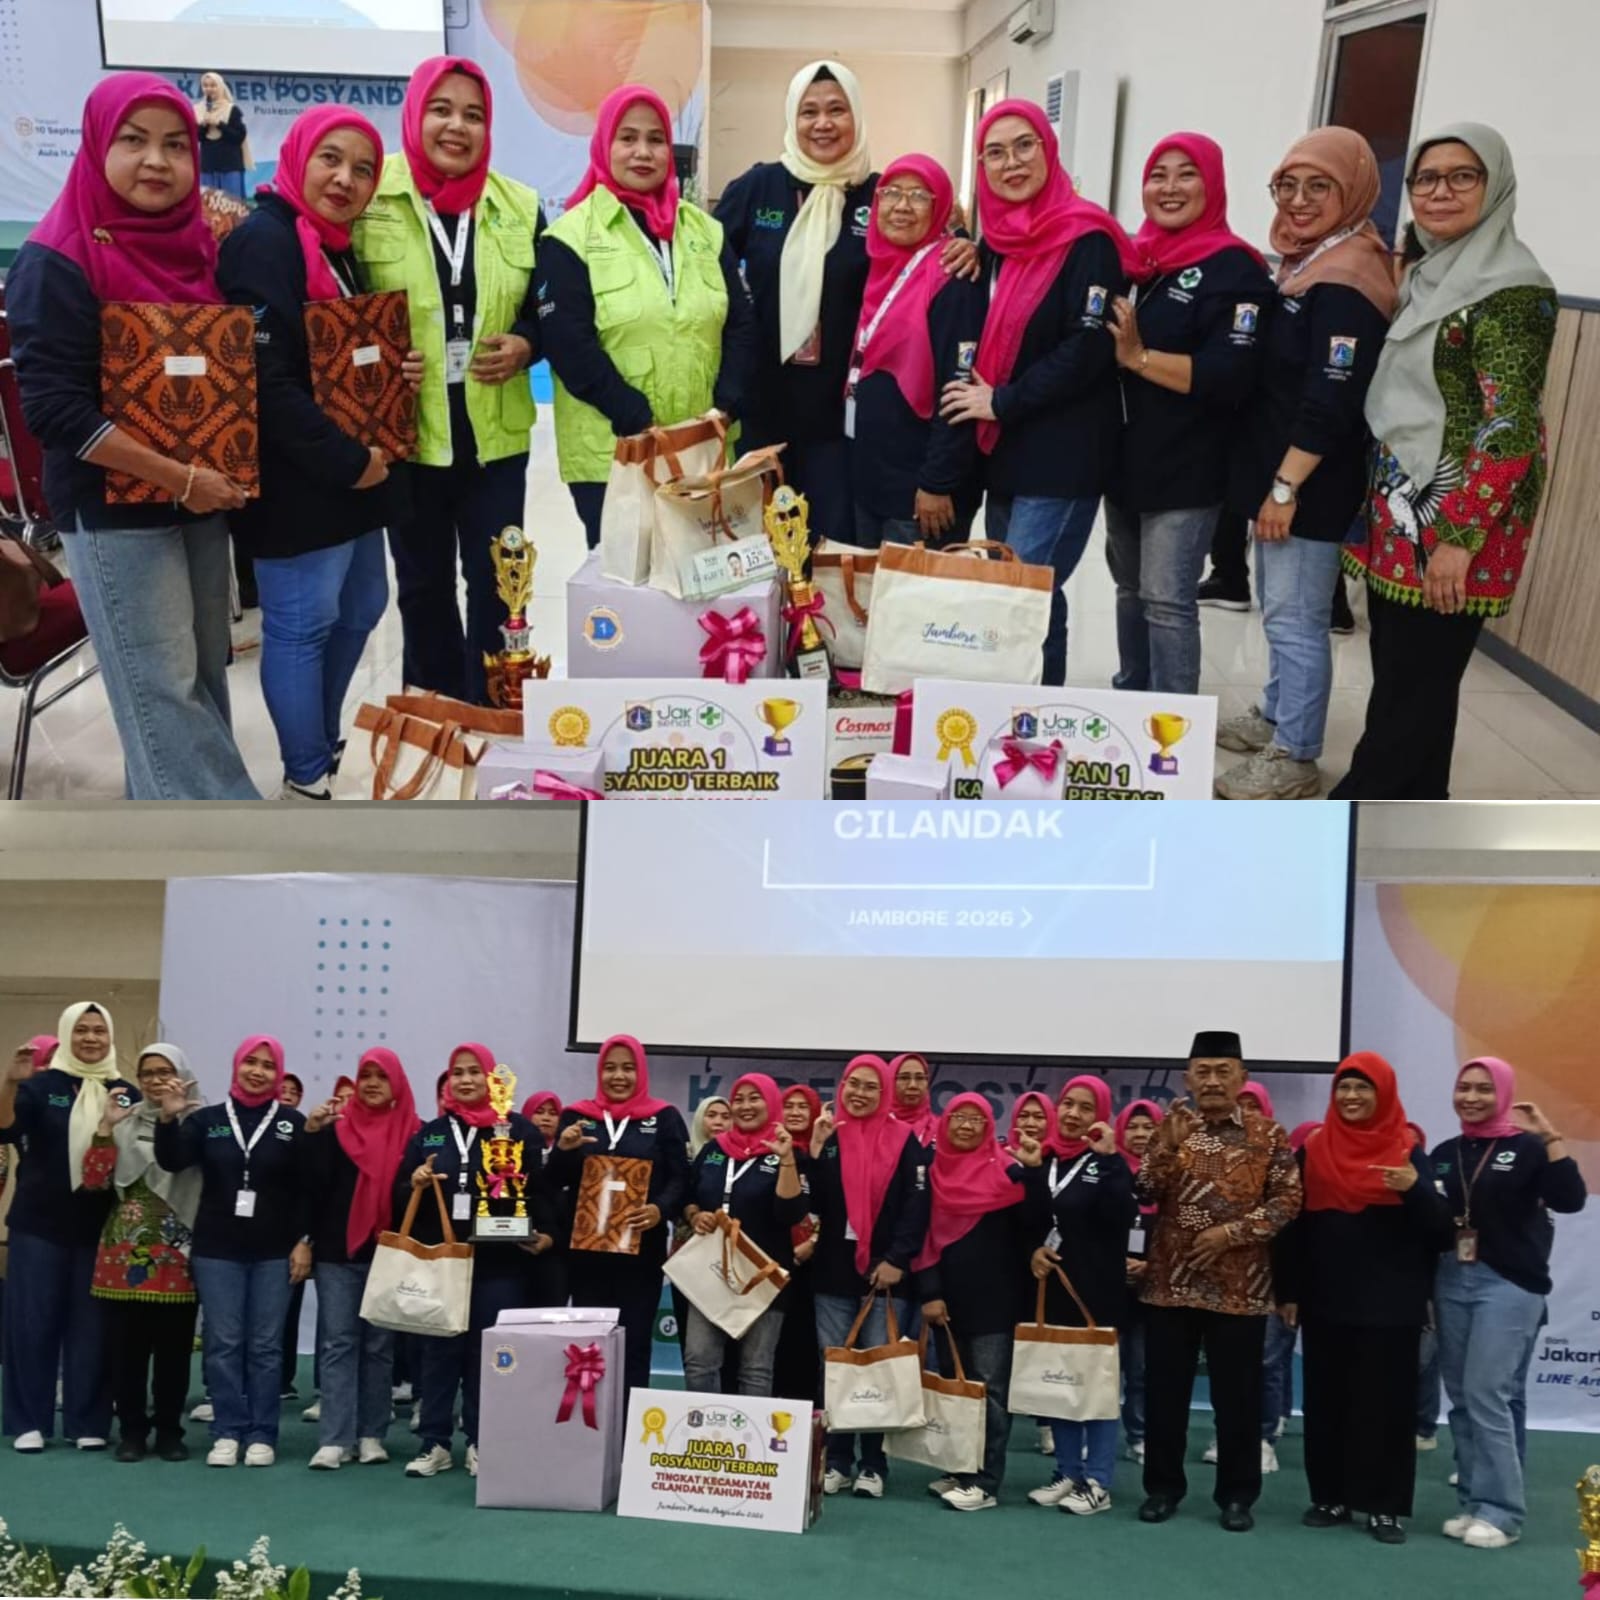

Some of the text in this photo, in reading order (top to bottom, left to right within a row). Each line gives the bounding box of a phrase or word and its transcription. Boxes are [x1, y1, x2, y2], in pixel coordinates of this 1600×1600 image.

[275, 82, 404, 106] POSYAND
[835, 716, 891, 733] Cosmos
[627, 747, 726, 772] JUARA 1
[691, 771, 779, 791] TERBAIK
[1116, 764, 1131, 787] 1
[833, 808, 1064, 840] CILANDAK
[847, 909, 1014, 927] JAMBORE 2026
[686, 1439, 747, 1459] JUARA 1
[651, 1453, 779, 1477] POSYANDU TERBAIK
[651, 1481, 773, 1501] CILANDAK TAHUN 2026
[655, 1472, 771, 1491] TINGKAT KECAMATAN
